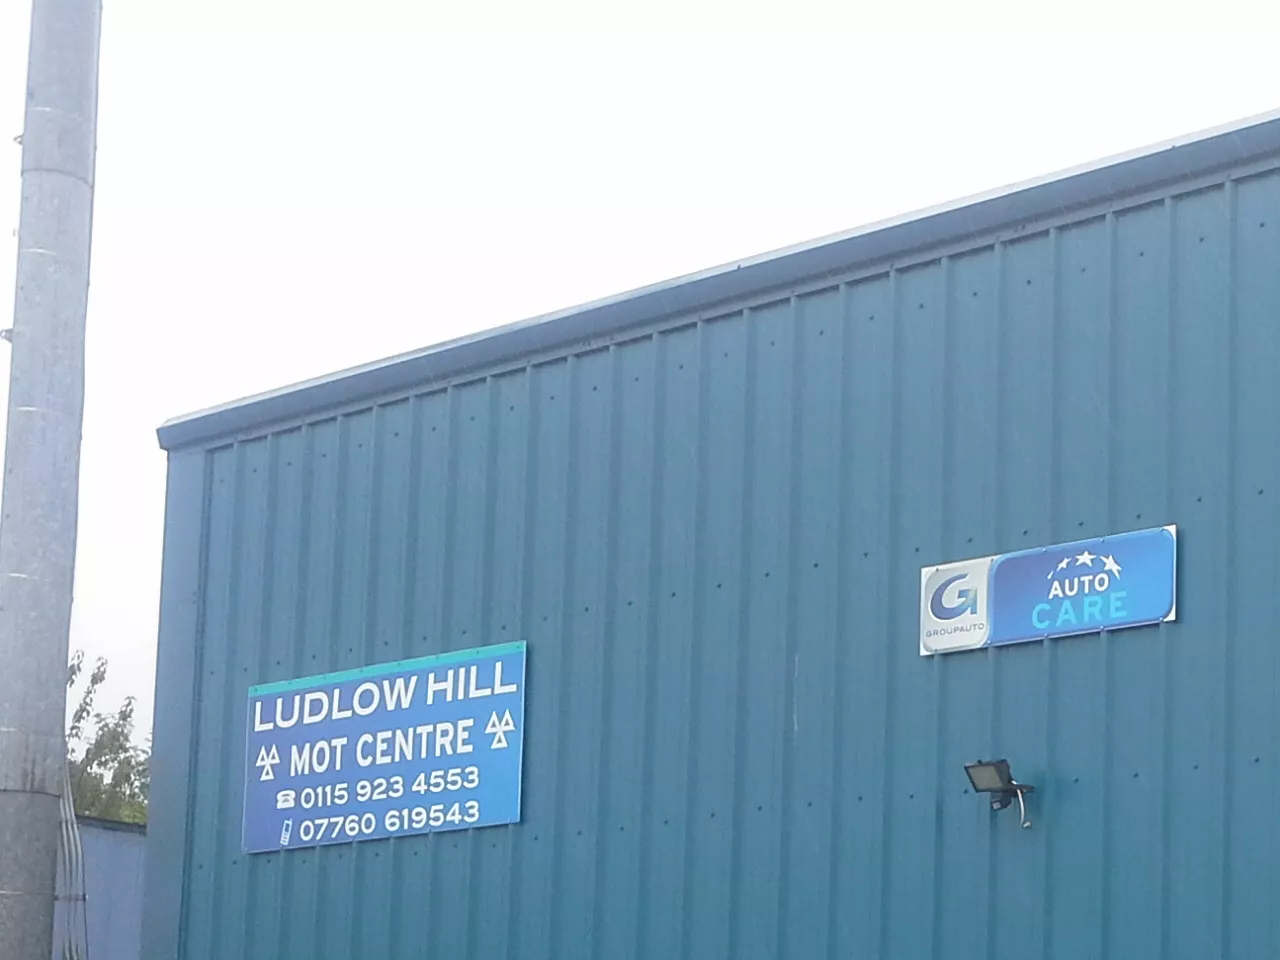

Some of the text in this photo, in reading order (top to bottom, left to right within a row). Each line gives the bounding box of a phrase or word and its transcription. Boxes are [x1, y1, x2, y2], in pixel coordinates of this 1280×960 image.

[1049, 572, 1109, 599] AUTO
[1032, 590, 1128, 630] CARE
[926, 622, 985, 639] GROUPAUTO
[254, 661, 517, 732] LUDLOW HILL
[290, 719, 474, 777] MOT CENTRE
[301, 766, 479, 809] 0115 923 4553
[300, 801, 479, 841] 07760 619543
